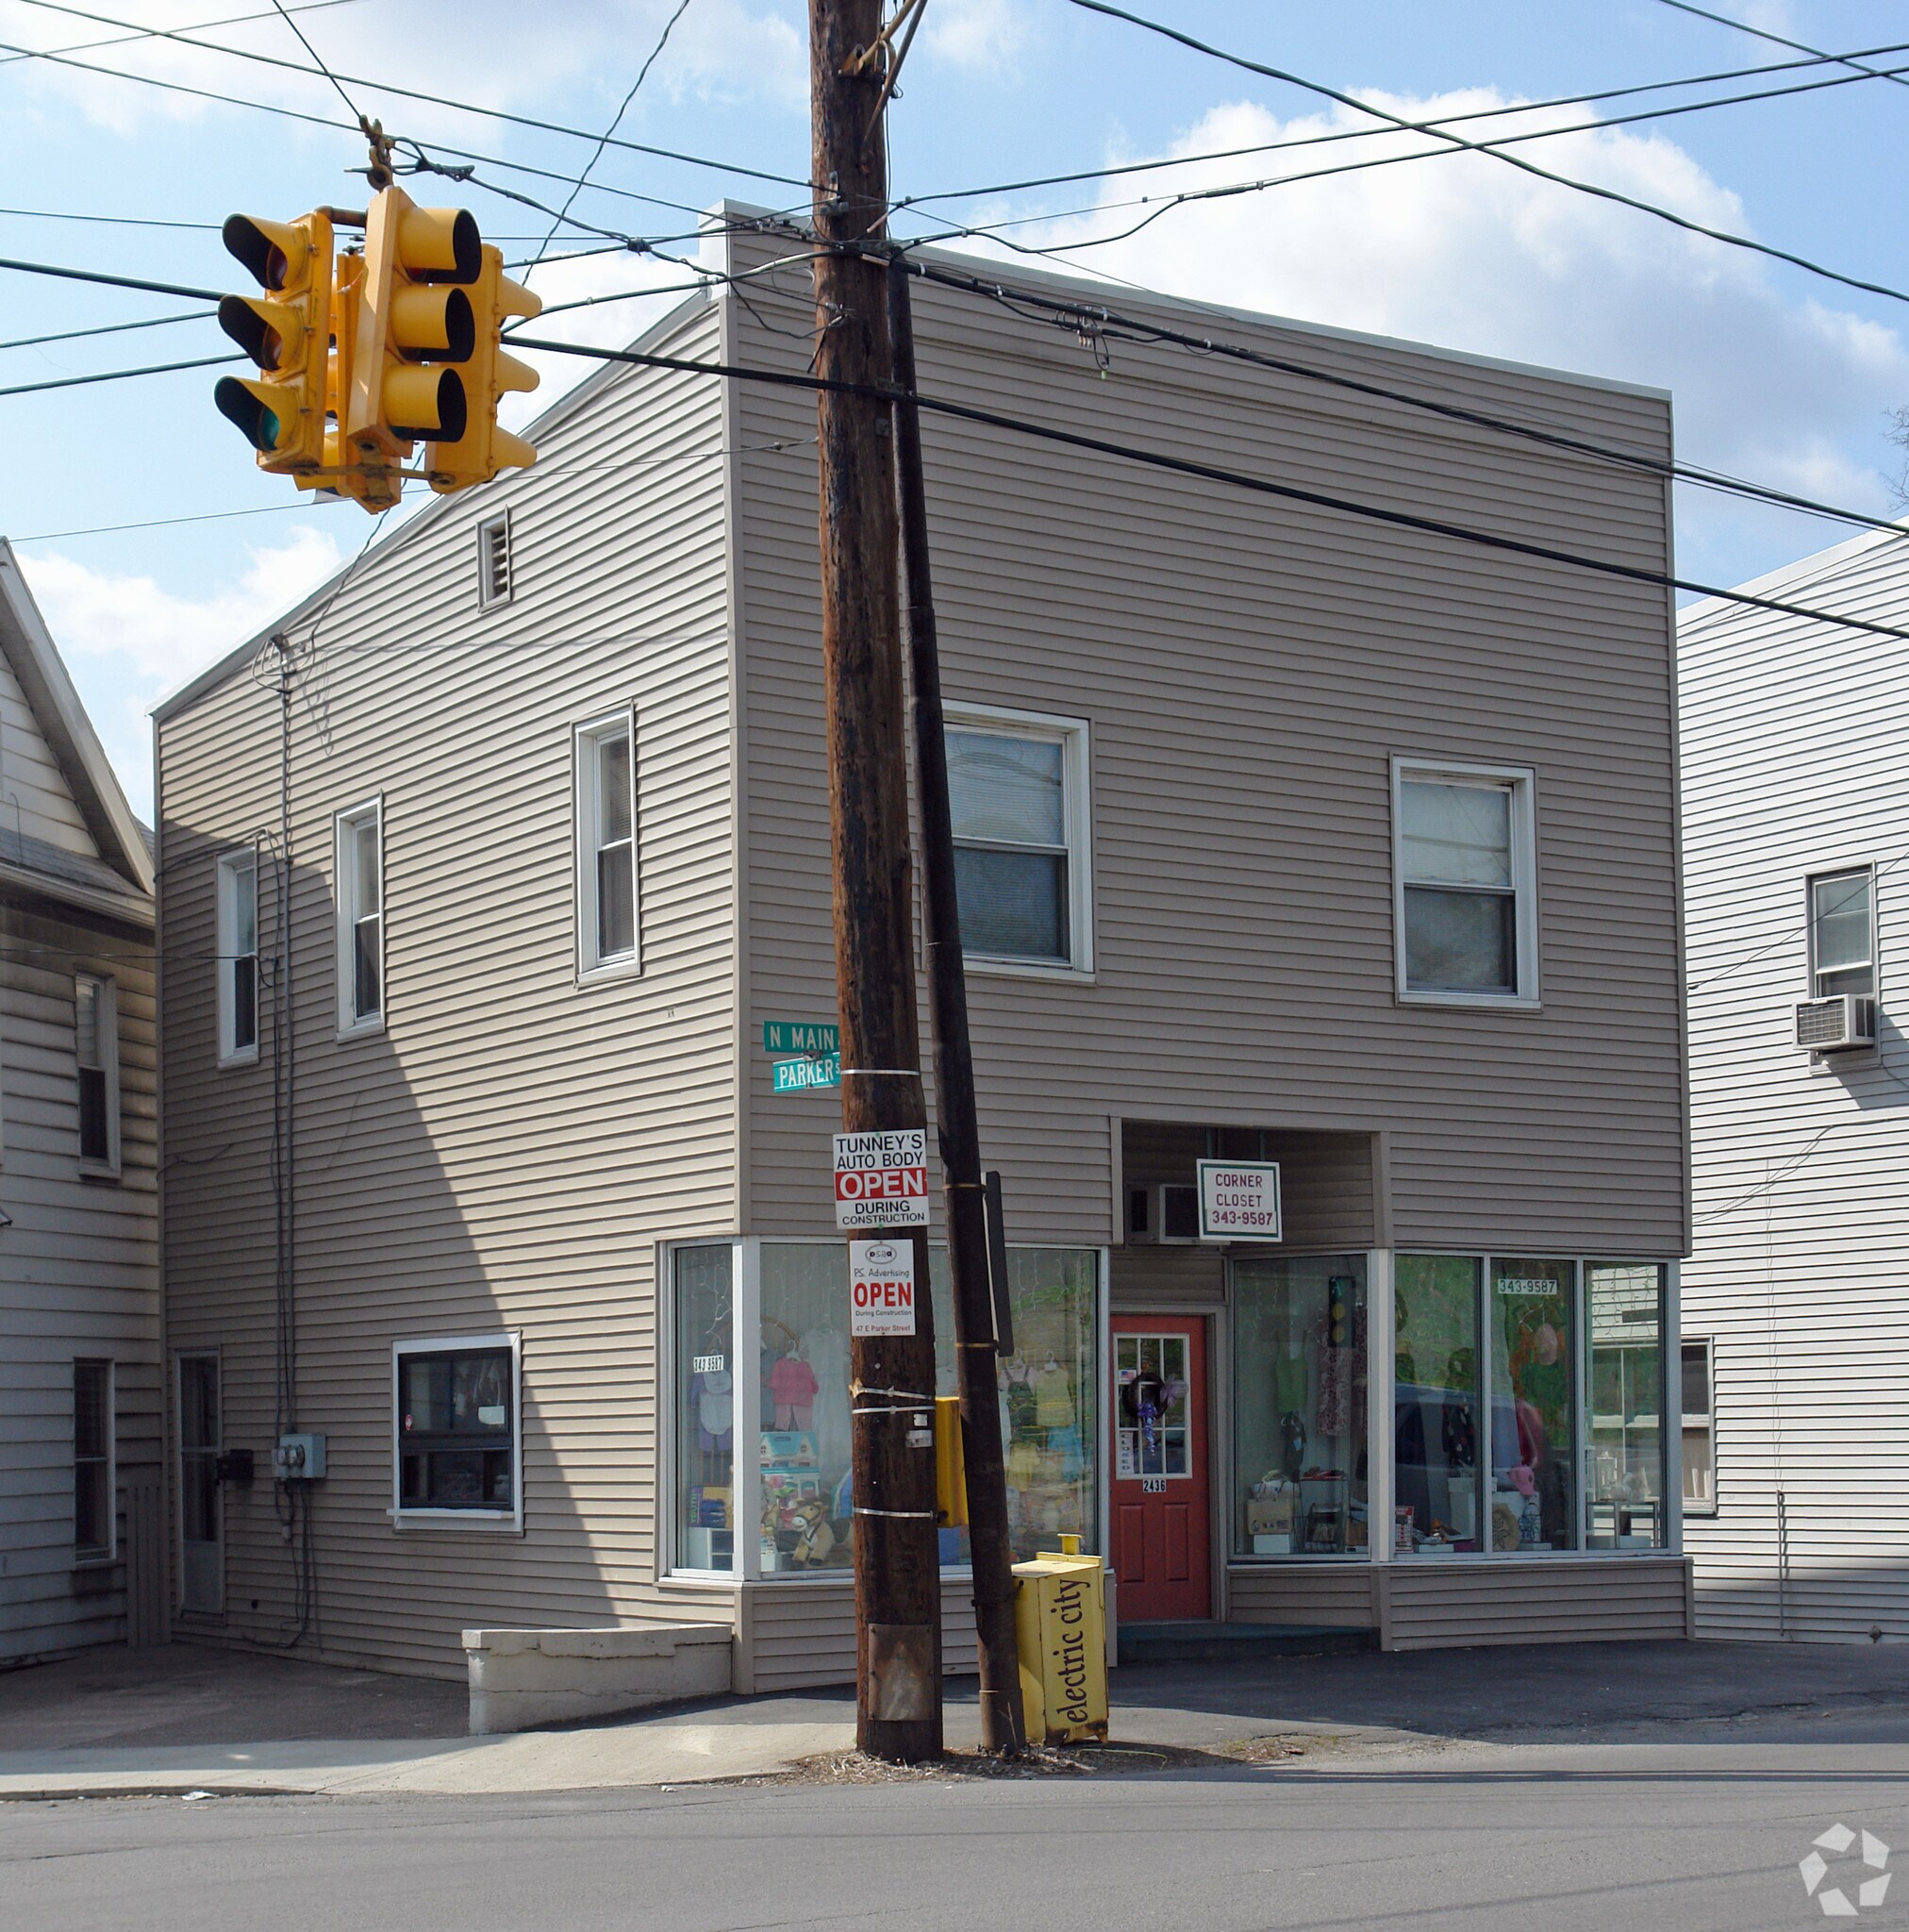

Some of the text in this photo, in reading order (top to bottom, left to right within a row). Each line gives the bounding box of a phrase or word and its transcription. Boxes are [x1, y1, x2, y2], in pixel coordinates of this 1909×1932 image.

[770, 1025, 834, 1050] N MAIN
[779, 1058, 834, 1088] PARKER
[836, 1134, 922, 1152] TUNNEY'S
[837, 1151, 923, 1170] AUTO BODY
[839, 1170, 923, 1199] OPEN
[1216, 1174, 1262, 1188] CORNER
[855, 1200, 910, 1214] DURING
[1216, 1193, 1262, 1208] CLOSET
[842, 1212, 925, 1225] CONSTRUCTION
[1212, 1210, 1272, 1225] 343-9587
[868, 1268, 910, 1278] Advertising
[1500, 1279, 1556, 1293] 343-9587
[854, 1282, 912, 1307] OPEN
[1143, 1479, 1166, 1492] 2436
[1050, 1579, 1091, 1723] electric city
